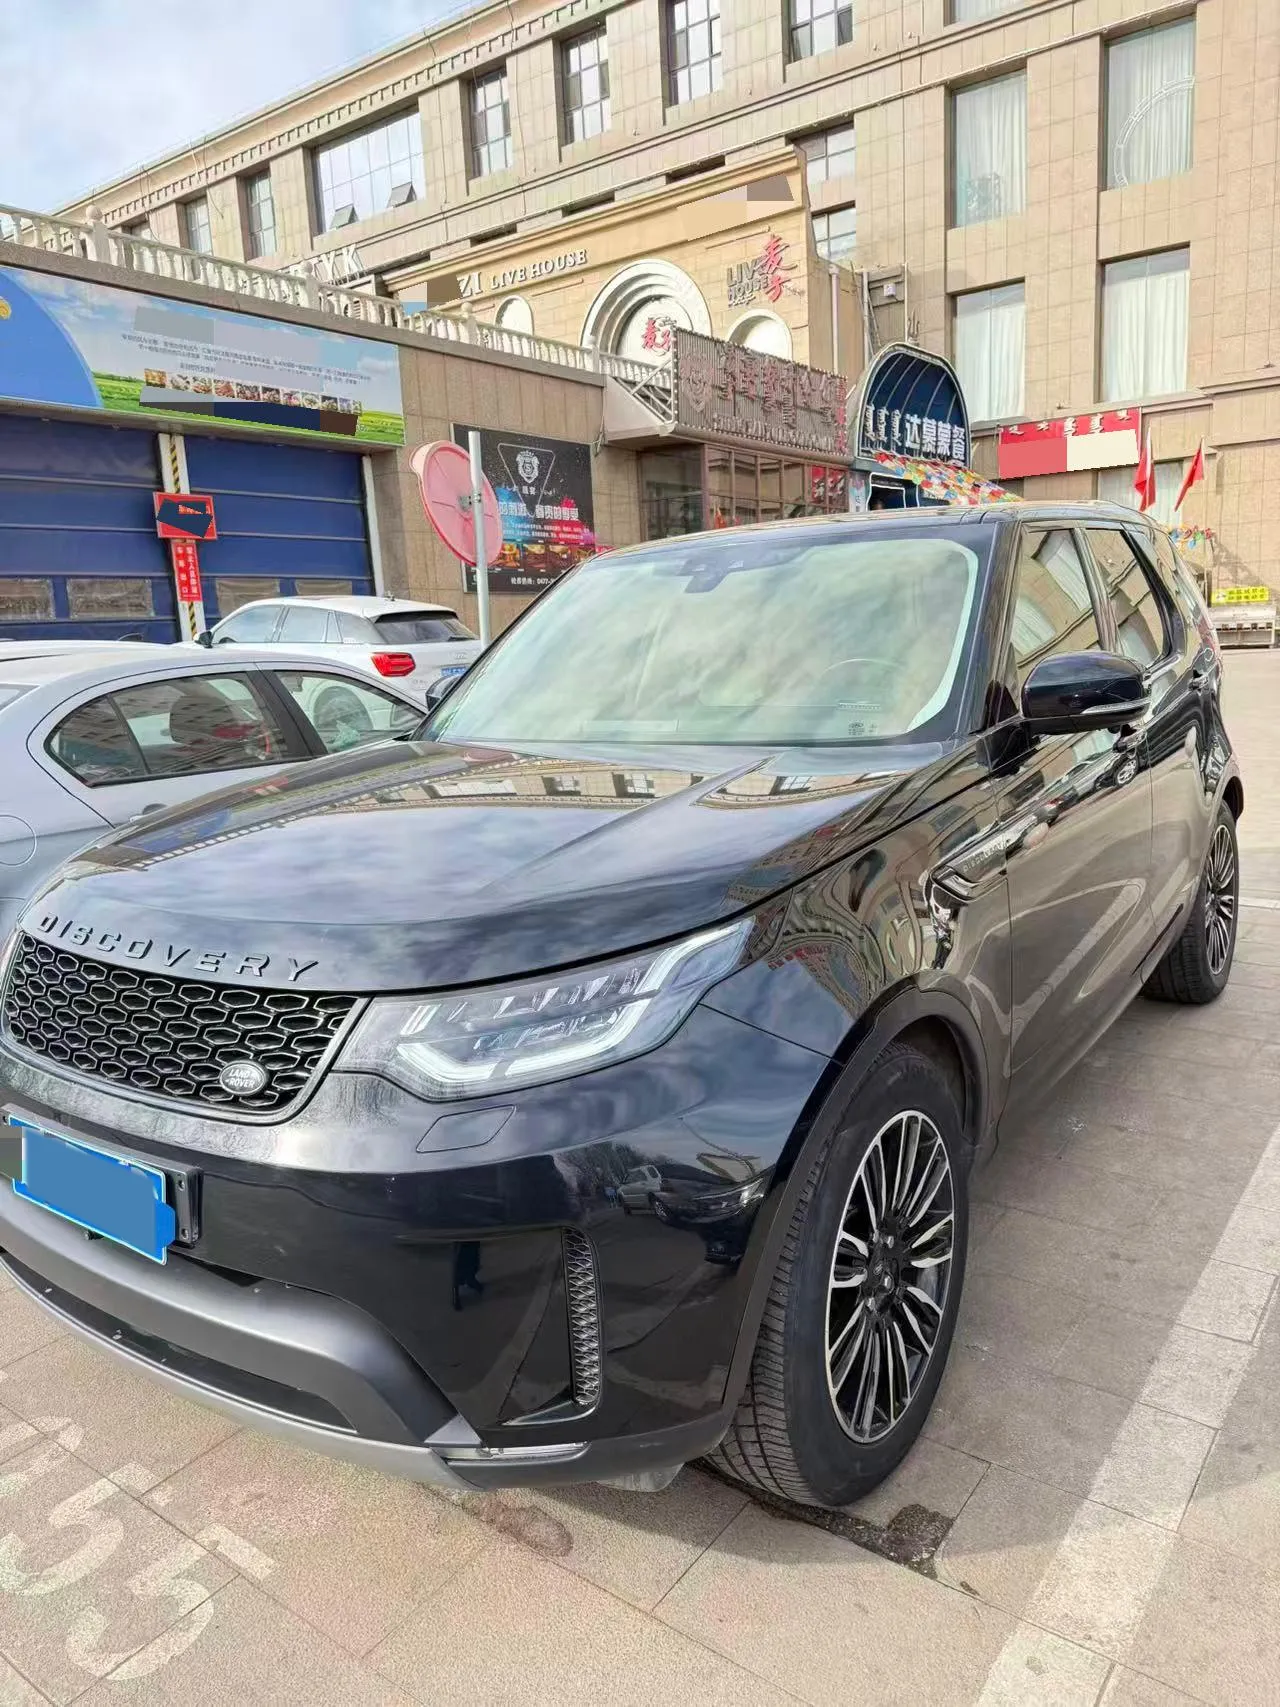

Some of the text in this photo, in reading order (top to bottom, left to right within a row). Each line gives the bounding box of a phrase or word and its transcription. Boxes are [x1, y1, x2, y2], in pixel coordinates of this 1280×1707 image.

[490, 267, 527, 290] LIVE
[529, 249, 588, 279] HOUSE
[40, 912, 319, 982] DISCOVERY
[229, 1069, 251, 1079] LAND
[229, 1078, 256, 1089] ROVER
